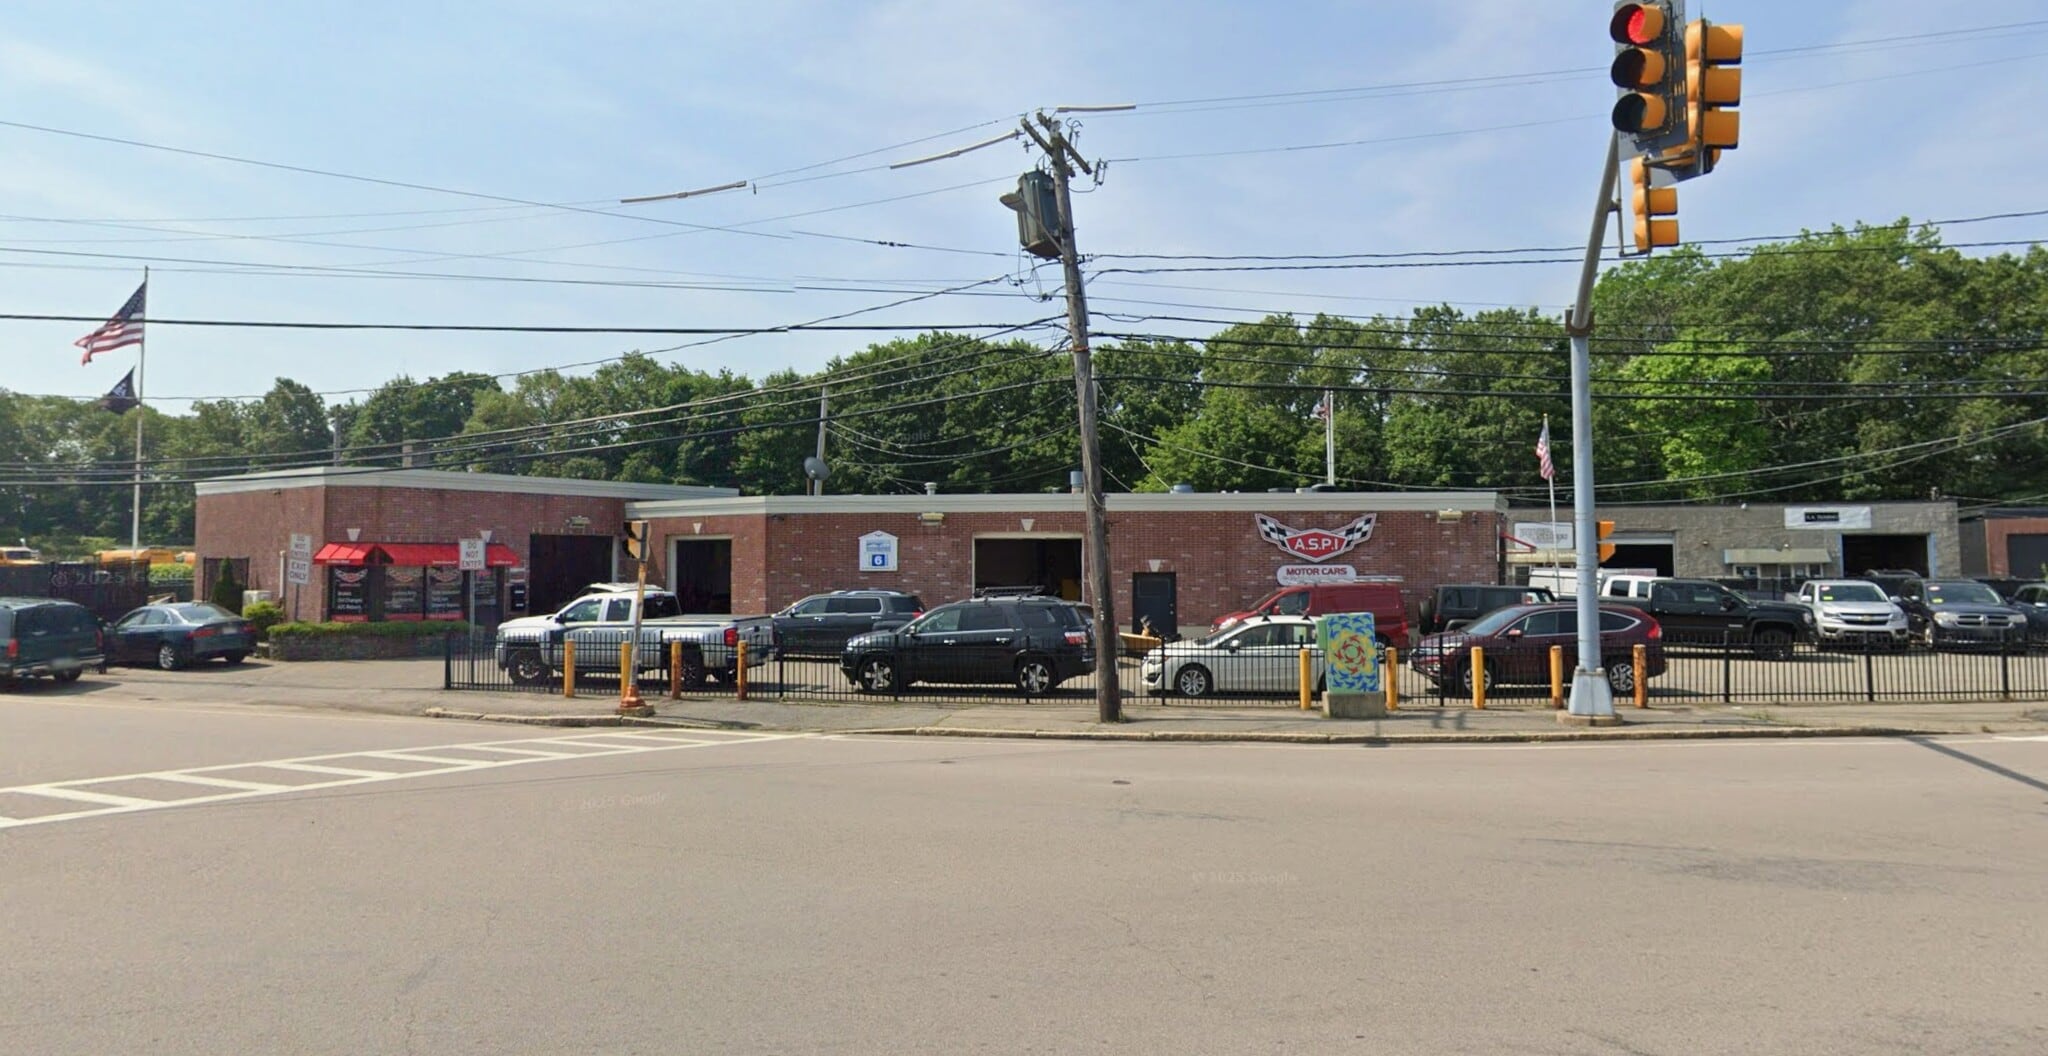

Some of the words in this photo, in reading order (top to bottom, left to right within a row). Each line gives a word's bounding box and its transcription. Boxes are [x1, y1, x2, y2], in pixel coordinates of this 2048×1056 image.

[467, 541, 477, 549] DO
[1294, 538, 1339, 550] A.S.P.I
[463, 560, 482, 568] ENTER
[874, 555, 883, 566] 6
[291, 561, 306, 570] EXIT
[289, 570, 307, 580] ONLY
[1286, 567, 1320, 576] MOTOR
[1321, 567, 1348, 576] CARS
